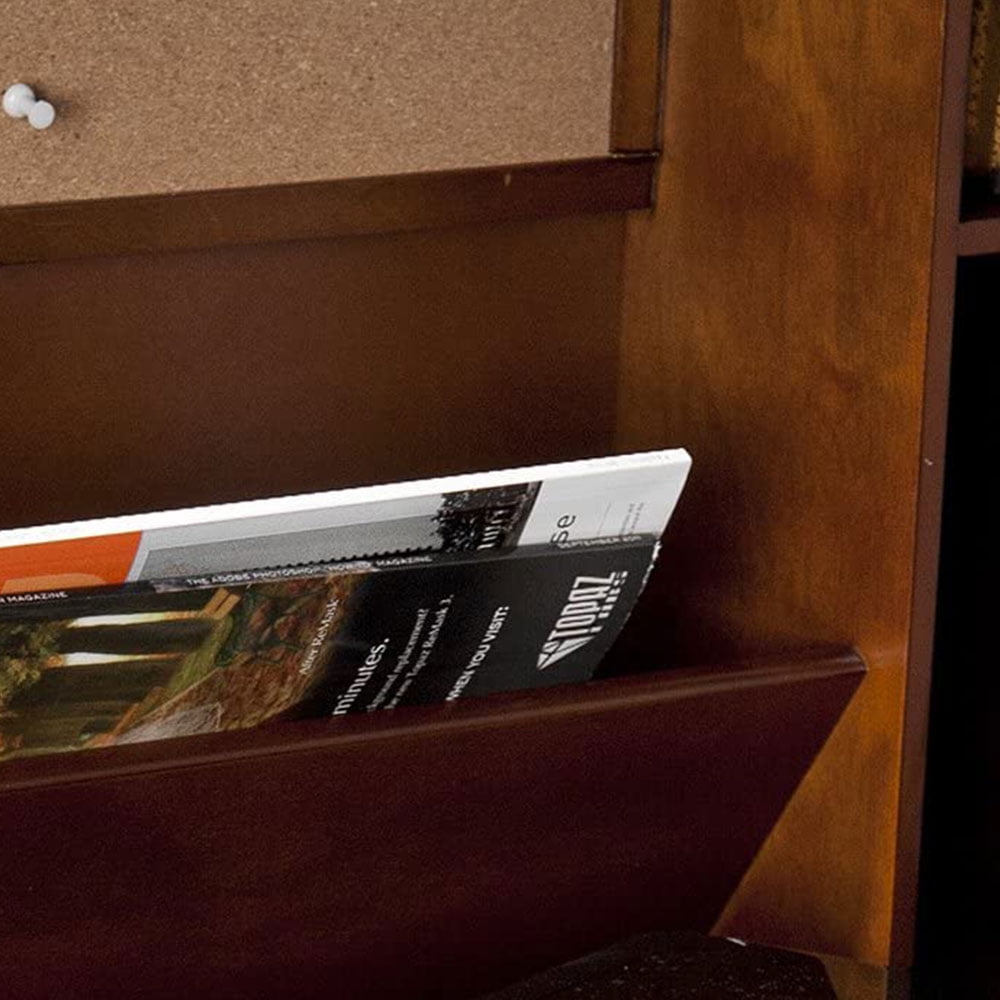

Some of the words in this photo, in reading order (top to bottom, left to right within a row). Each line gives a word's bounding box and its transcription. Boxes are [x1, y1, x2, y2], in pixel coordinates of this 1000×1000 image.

[6, 591, 68, 604] MAGAZINE
[466, 644, 492, 670] YOU
[481, 606, 510, 643] VISIT:
[332, 637, 390, 716] minutes.
